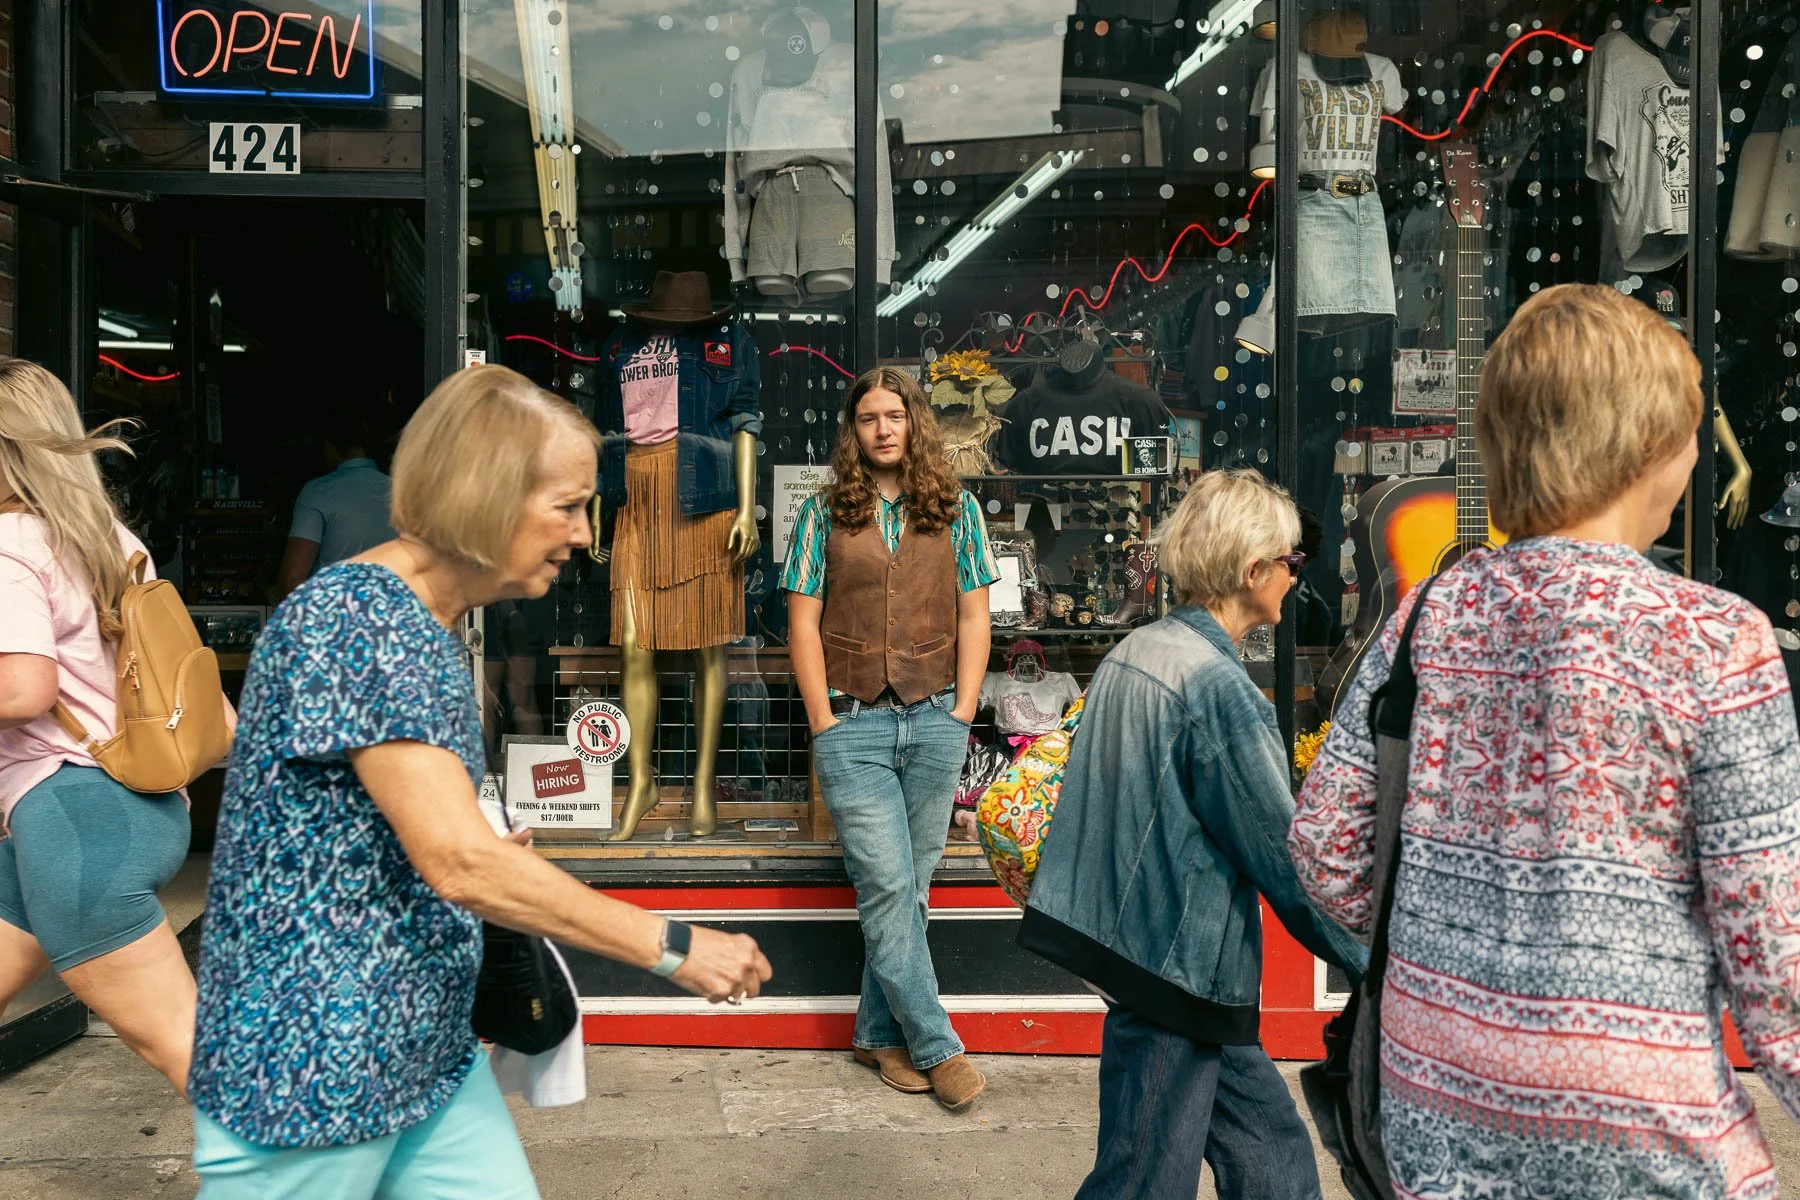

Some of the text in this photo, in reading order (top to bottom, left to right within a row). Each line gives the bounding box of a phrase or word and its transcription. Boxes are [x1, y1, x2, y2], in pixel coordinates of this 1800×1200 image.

[170, 9, 362, 79] OPEN
[1299, 78, 1385, 118] NASH
[1304, 115, 1380, 152] VILLE
[212, 124, 298, 172] 424
[619, 361, 679, 384] OWER BROA
[1029, 414, 1132, 458] CASH
[1134, 439, 1157, 448] CASH
[800, 470, 820, 481] See
[791, 492, 807, 502] you
[572, 703, 622, 724] NO PUBLIC
[572, 742, 627, 764] RESTROOMS
[546, 764, 570, 774] Now
[536, 774, 580, 791] HIRING
[483, 788, 496, 798] 24
[516, 801, 540, 810] EVENING
[548, 802, 578, 811] WEEKEND
[579, 802, 601, 811] SHIFTS
[540, 813, 574, 822] $17/HOUR
